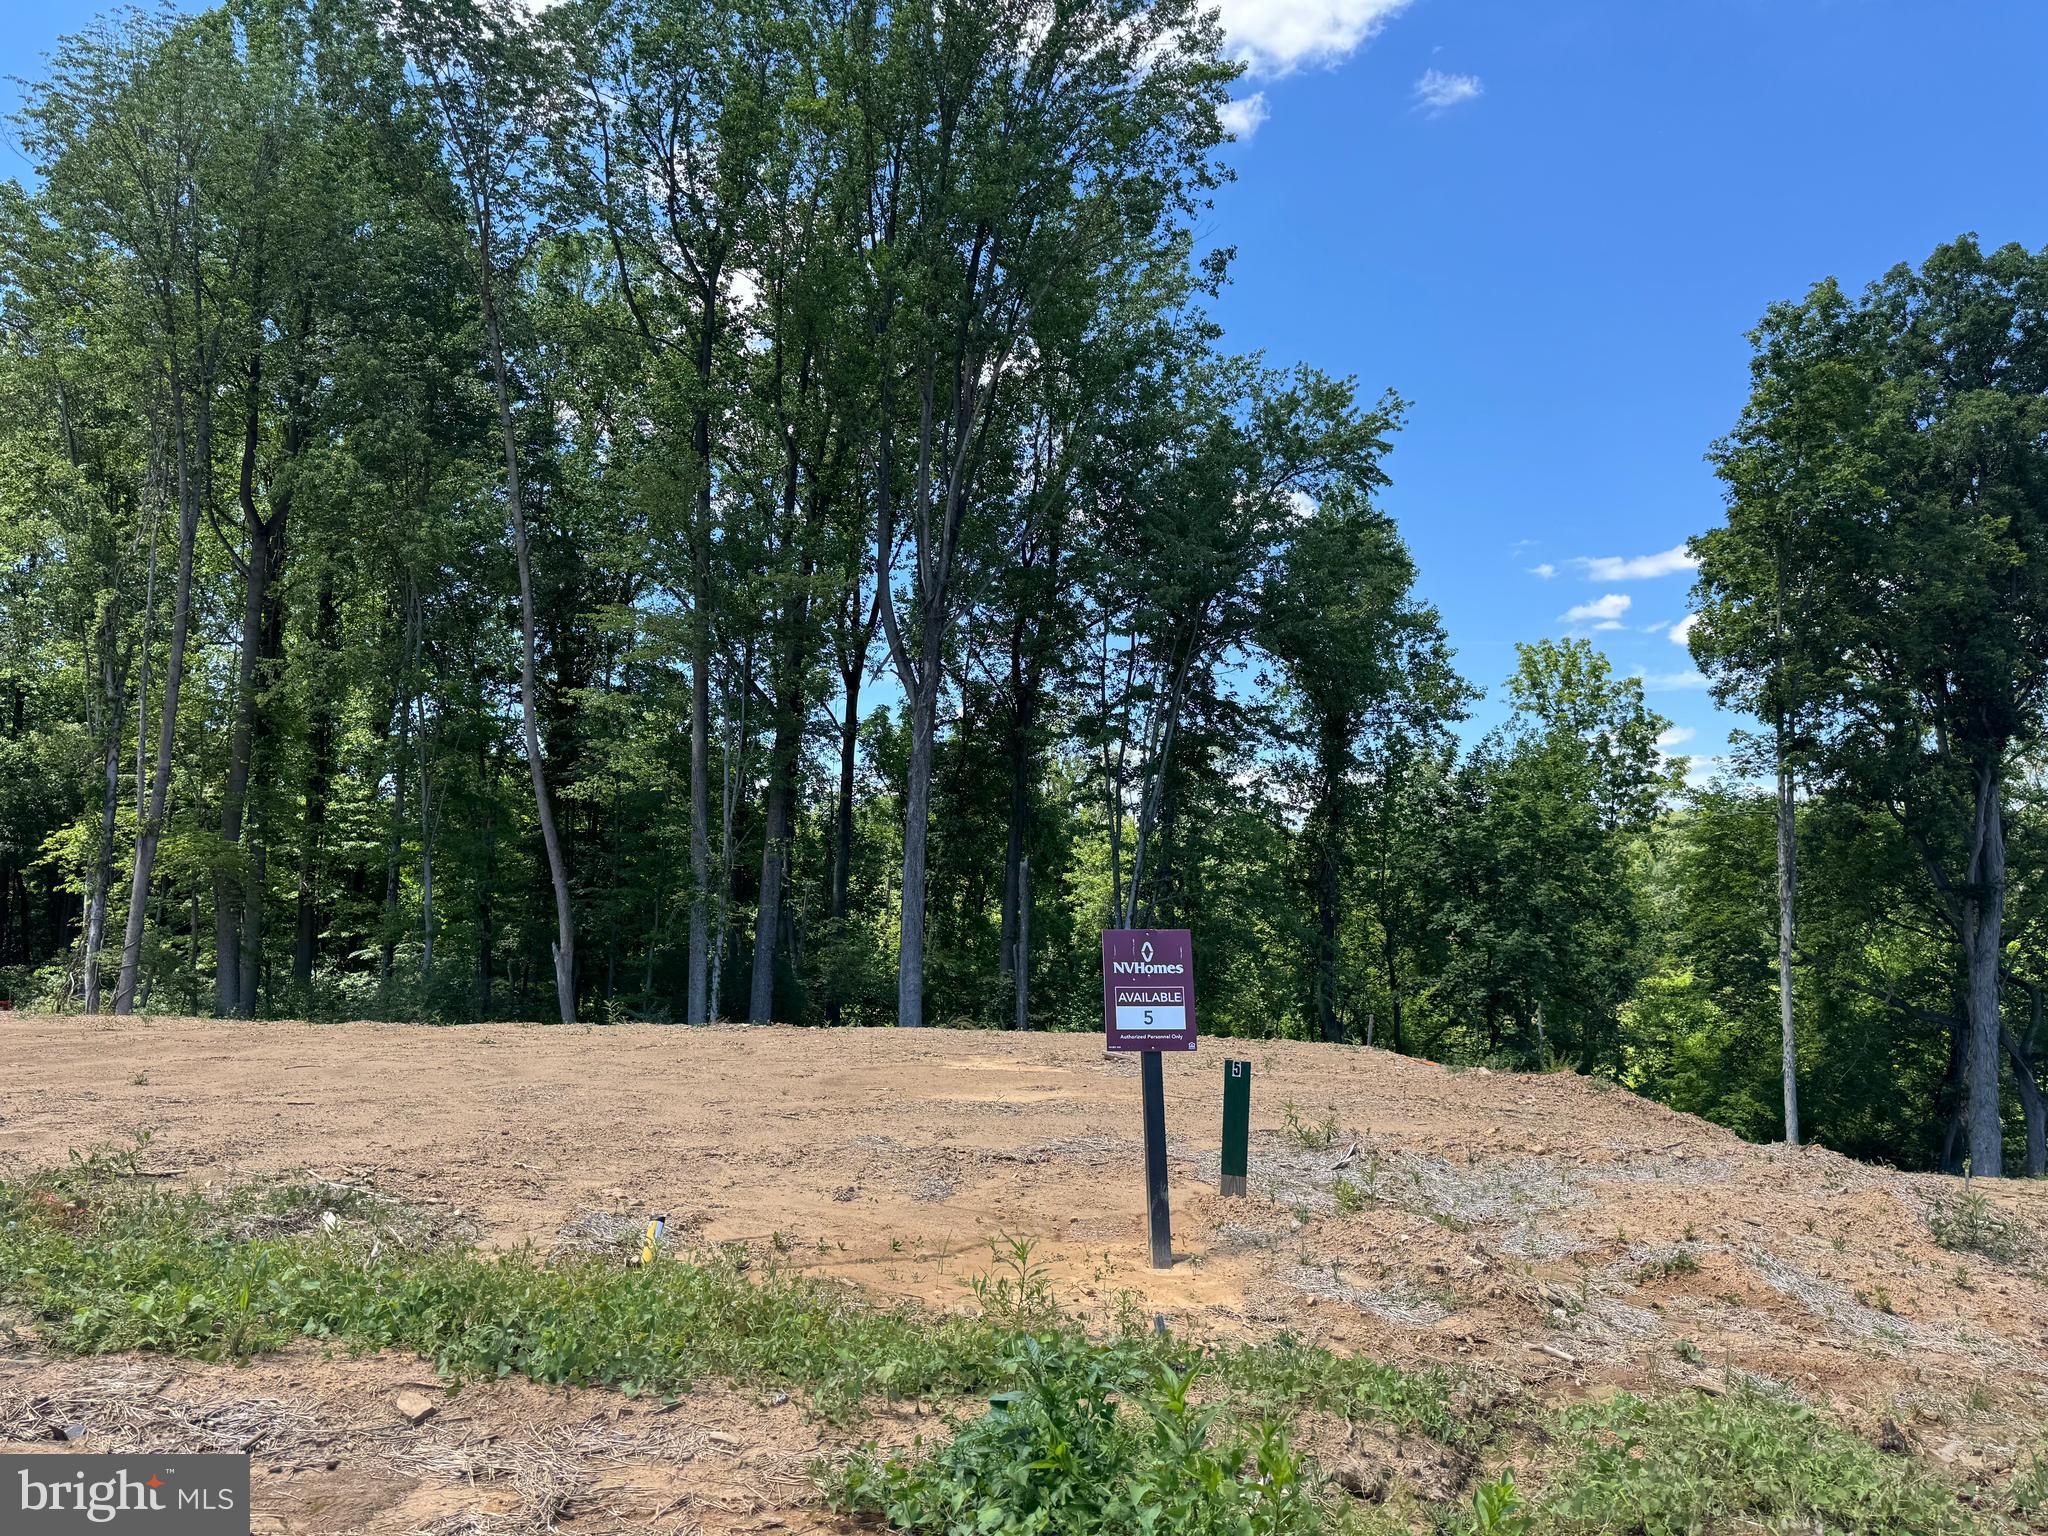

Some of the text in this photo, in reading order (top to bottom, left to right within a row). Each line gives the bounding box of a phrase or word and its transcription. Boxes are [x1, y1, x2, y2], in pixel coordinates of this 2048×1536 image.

[1113, 962, 1184, 974] NVHomes
[1118, 992, 1182, 1003] AVAILABLE
[1143, 1010, 1154, 1025] 5
[1233, 1062, 1241, 1076] 5
